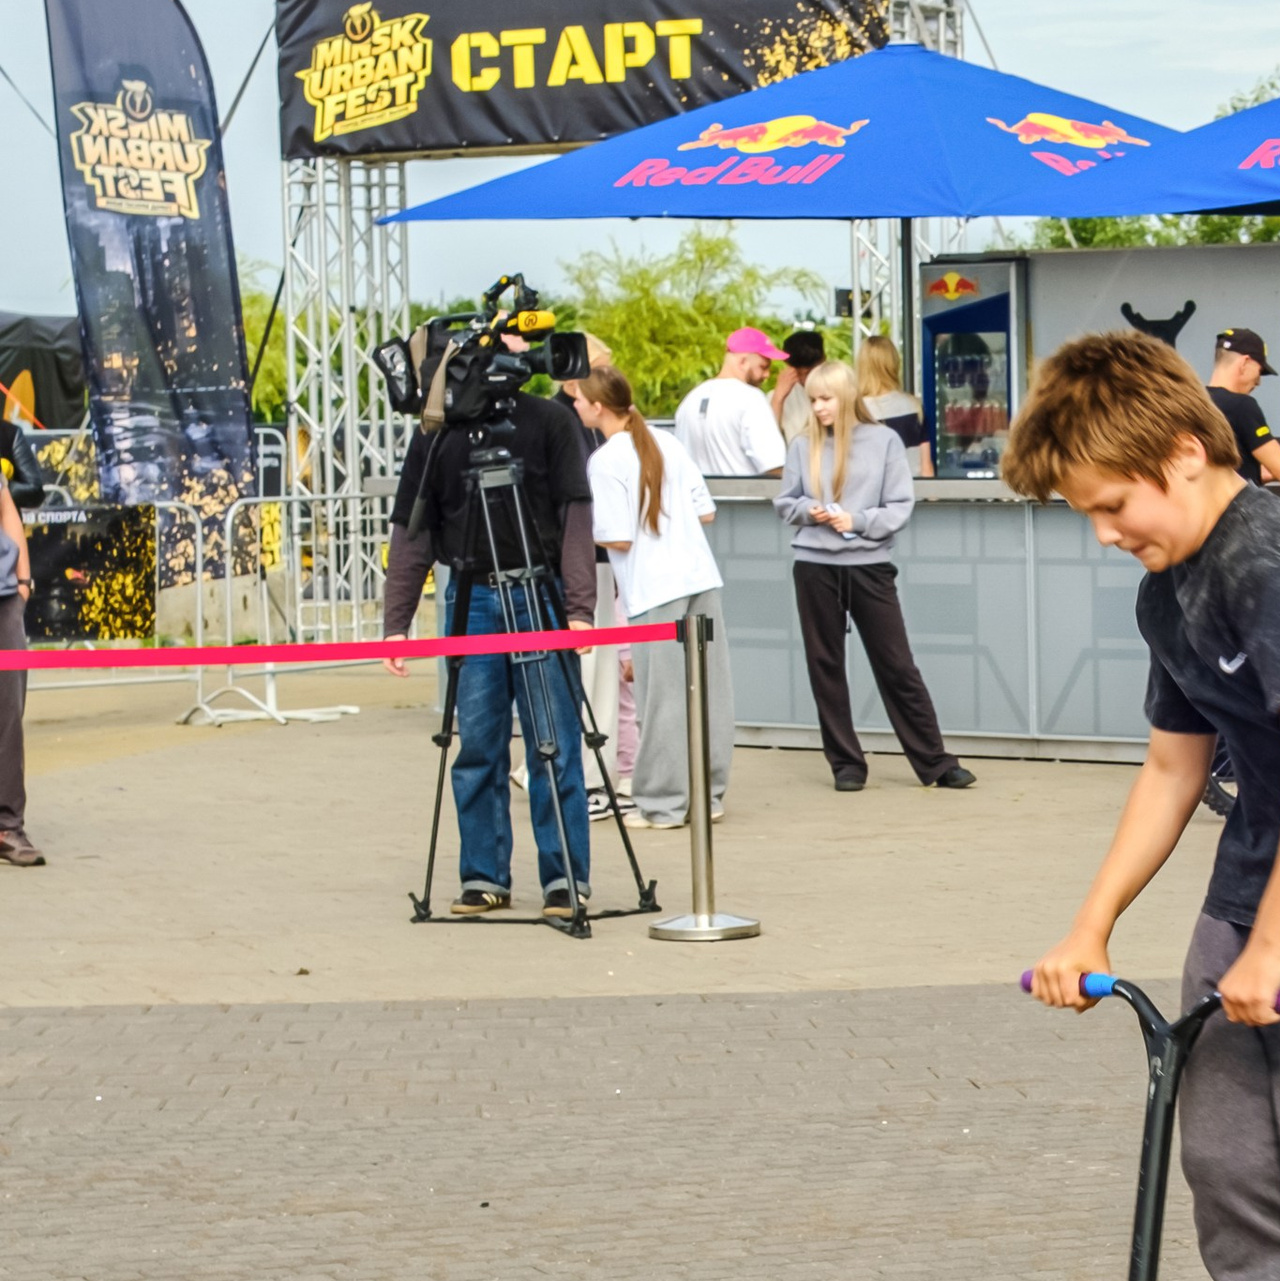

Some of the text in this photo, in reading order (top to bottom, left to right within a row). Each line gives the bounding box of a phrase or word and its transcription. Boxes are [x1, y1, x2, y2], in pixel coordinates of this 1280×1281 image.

[309, 42, 424, 99] URBAN
[315, 19, 418, 72] MINSK
[450, 18, 703, 93] СТАРТ
[322, 72, 415, 131] FEST
[612, 154, 845, 188] Red Bull
[37, 510, 87, 524] СПОРТА
